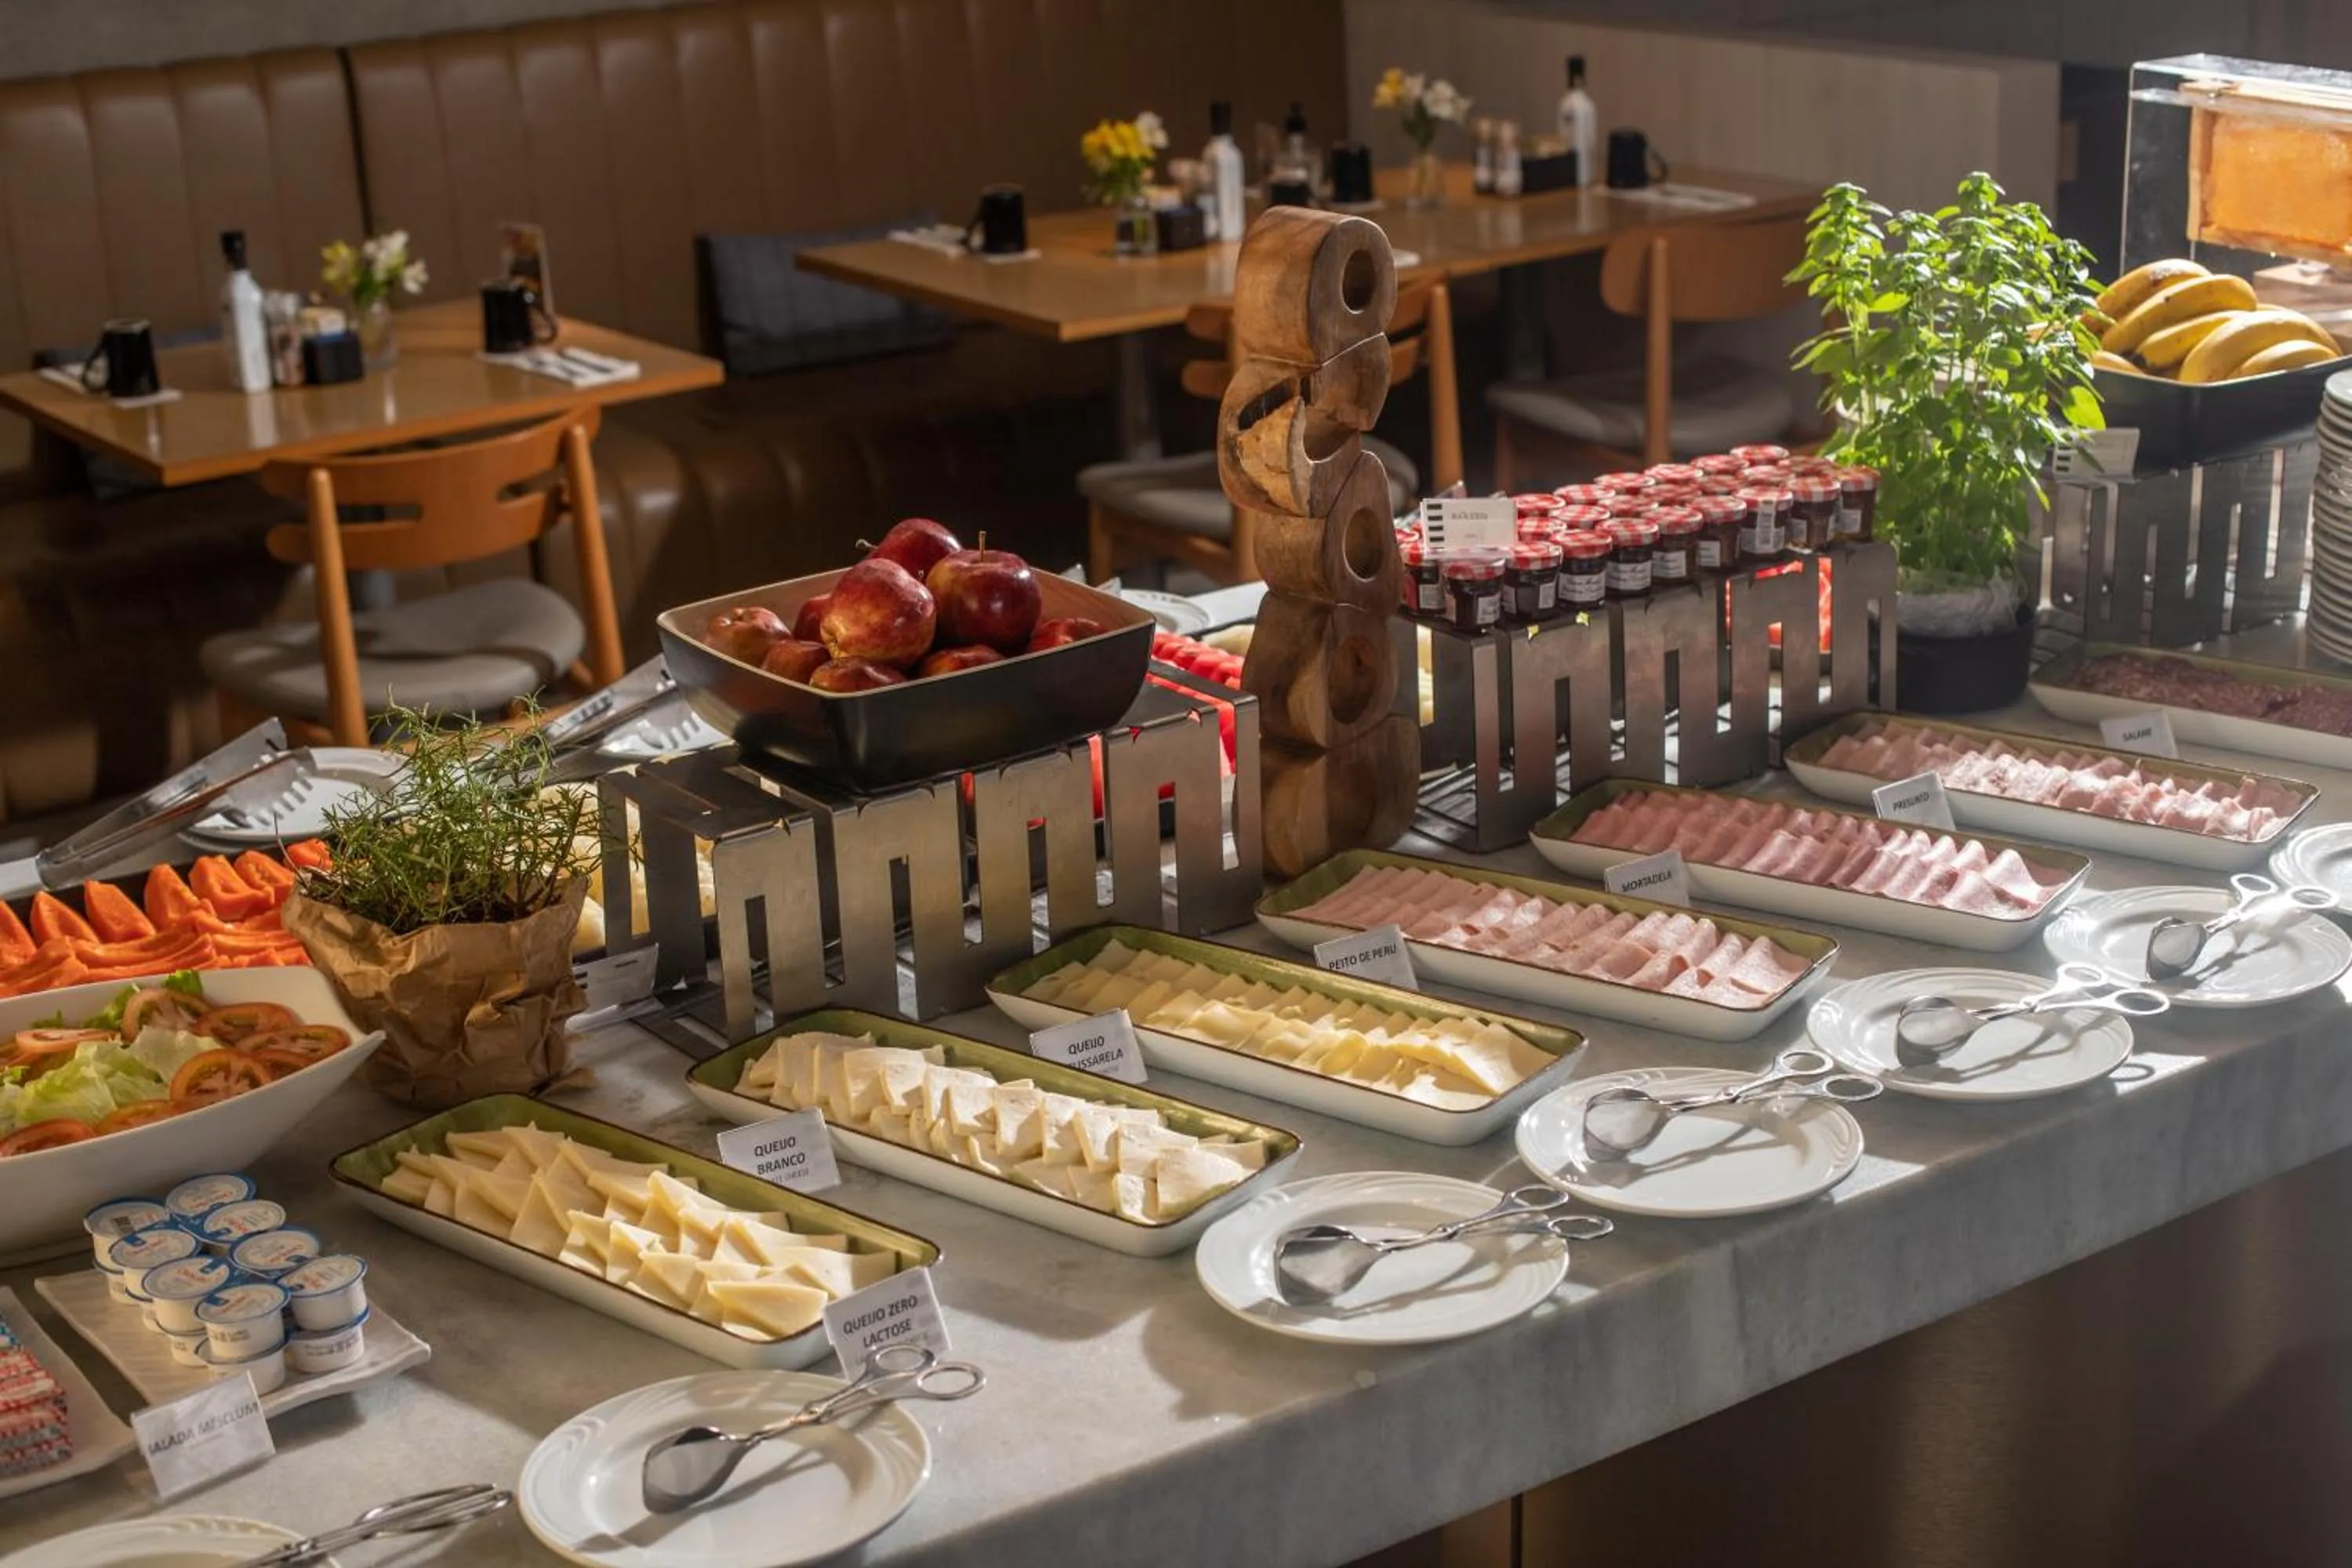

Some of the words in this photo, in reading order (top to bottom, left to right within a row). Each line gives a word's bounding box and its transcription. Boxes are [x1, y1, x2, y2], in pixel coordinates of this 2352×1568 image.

[1621, 870, 1672, 892] MORTADELA
[1329, 955, 1357, 970] PEITO
[1359, 951, 1370, 962] DE
[1372, 944, 1396, 958] PERU
[1068, 1035, 1105, 1054] QUEIJO
[1069, 1047, 1123, 1069] USSARELA
[753, 1136, 797, 1157] QUEIJO
[757, 1152, 806, 1175] BRANCO
[843, 1308, 885, 1334] QUEIJO
[888, 1294, 918, 1317] ZERO
[863, 1319, 912, 1348] LACTOSE
